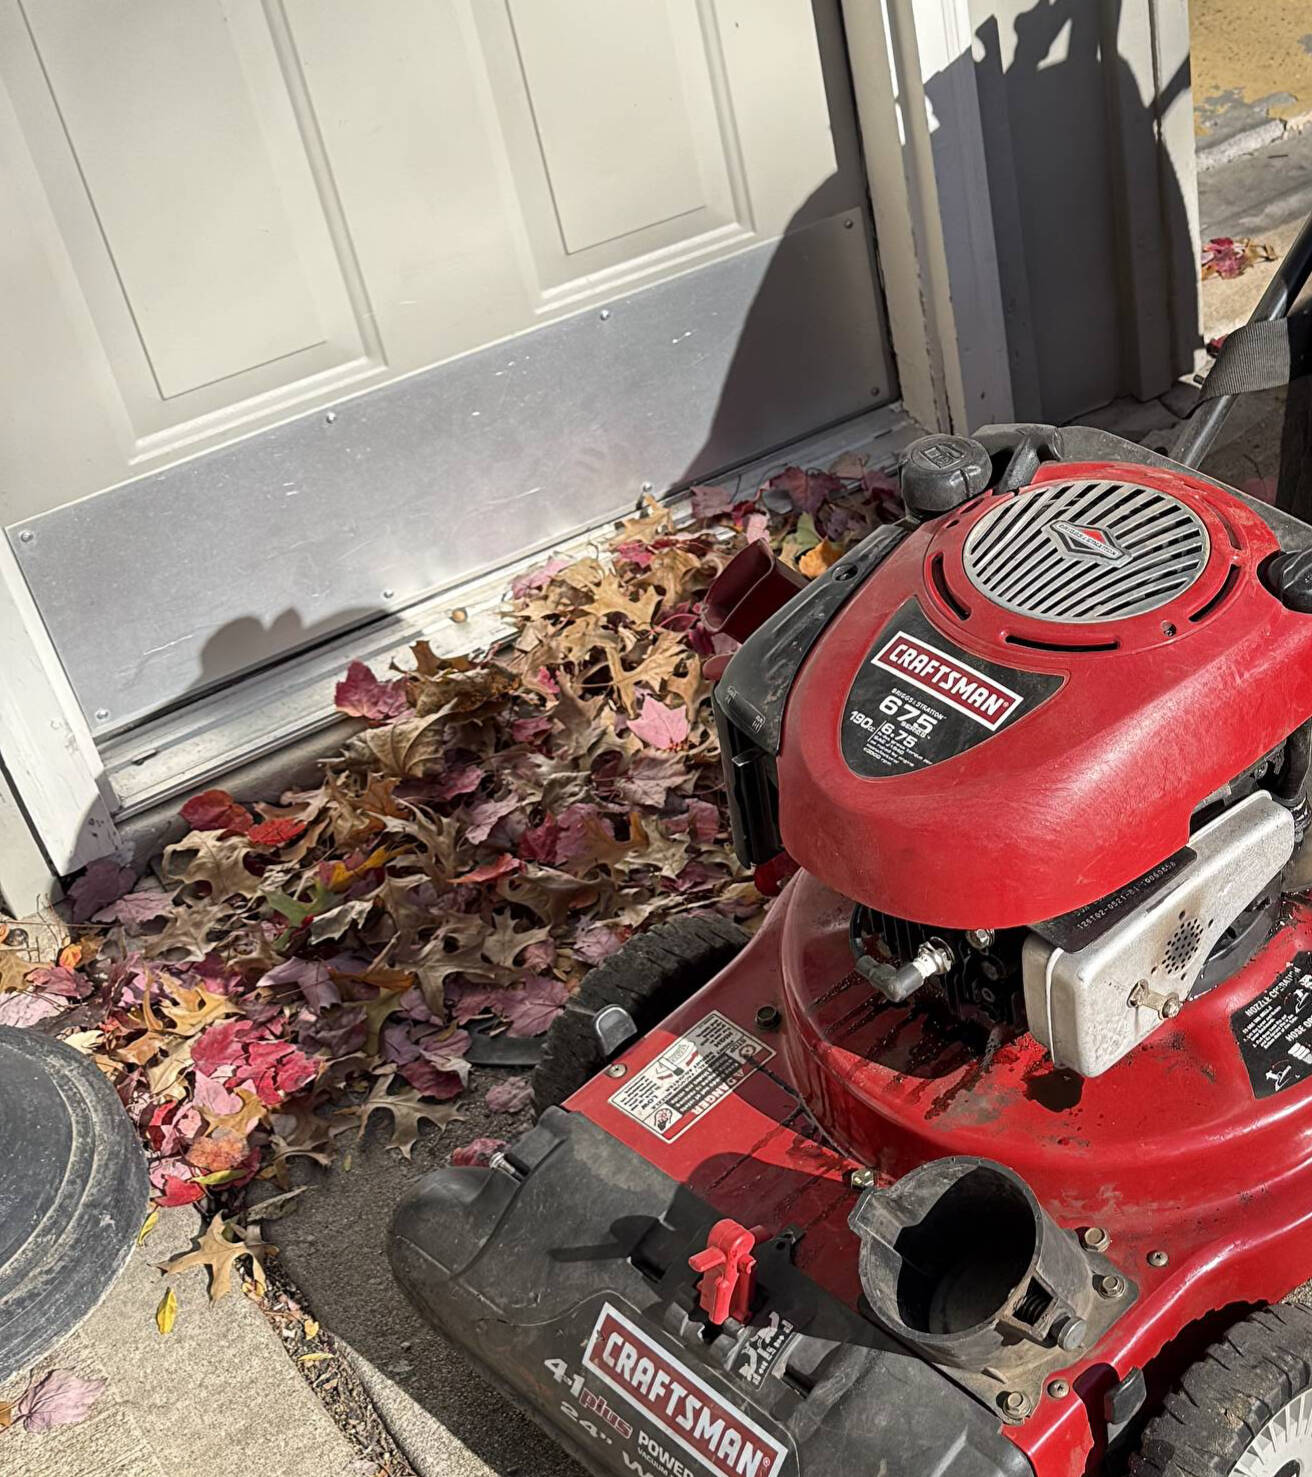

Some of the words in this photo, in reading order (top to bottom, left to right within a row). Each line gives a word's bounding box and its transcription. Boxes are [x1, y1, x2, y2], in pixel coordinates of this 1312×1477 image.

[879, 695, 938, 735] 675
[881, 721, 918, 748] 6.75
[1285, 1025, 1306, 1042] HOSE
[690, 1076, 737, 1114] DANGER
[602, 1332, 764, 1477] CRAFTSMAN
